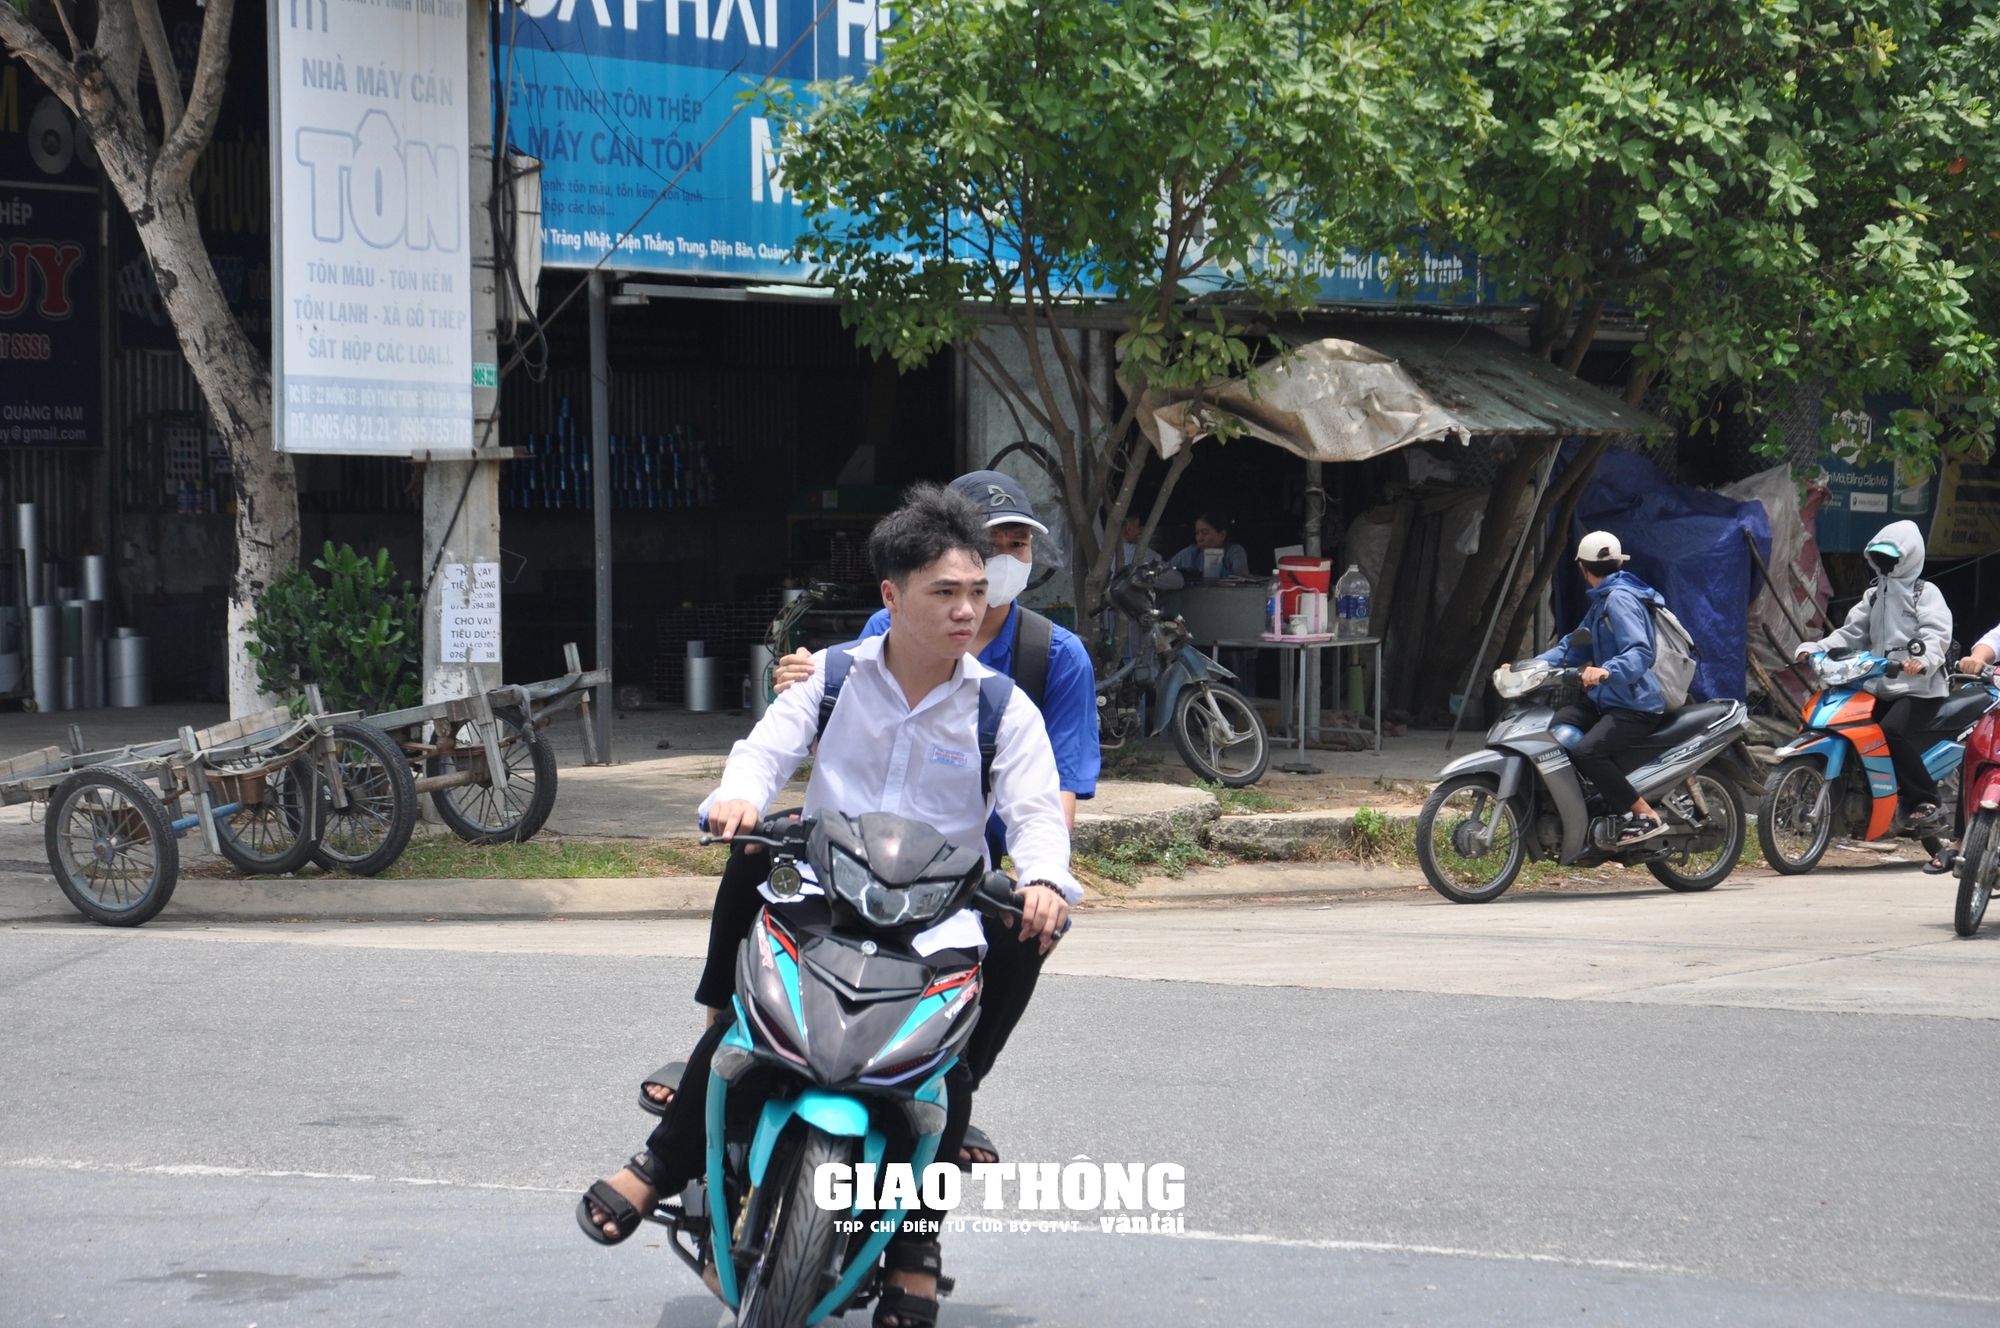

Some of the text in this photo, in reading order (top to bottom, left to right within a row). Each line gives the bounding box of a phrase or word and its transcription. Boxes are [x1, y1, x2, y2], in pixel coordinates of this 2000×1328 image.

[302, 53, 348, 92] NHÀ
[356, 60, 402, 100] MÁY
[410, 68, 453, 106] CÁN
[525, 83, 548, 109] TY
[553, 86, 607, 114] TNHH
[612, 87, 652, 119] TÔN
[657, 93, 703, 123] THÉP
[527, 120, 583, 162] MÁY
[590, 126, 643, 168] CÁN
[651, 132, 703, 172] TÔN
[295, 108, 462, 253] TÔN
[568, 179, 586, 193] tôn
[616, 183, 634, 197] tôn
[567, 197, 584, 214] các
[616, 233, 641, 255] Điện
[676, 236, 708, 259] Trung,
[710, 237, 733, 260] Điện
[735, 238, 756, 259] Bàn,
[307, 257, 337, 285] TÔN
[342, 260, 375, 288] MÀU
[388, 264, 418, 291] TÔN
[293, 293, 324, 321] TÔN
[329, 301, 368, 327] LẠNH
[383, 300, 401, 327] XÀ
[428, 304, 467, 330] THÉP
[11, 333, 51, 360] SSSC
[308, 329, 337, 359] SẮT
[342, 335, 372, 365] HỘP
[376, 337, 405, 363] CÁC
[3, 400, 84, 421] QUẢNG NAM
[312, 412, 341, 440] 0905
[343, 414, 357, 441] 48
[360, 414, 373, 441] 21
[376, 415, 390, 442] 21
[400, 415, 427, 443] 0905
[430, 417, 450, 443] 735
[453, 418, 471, 443] 779
[451, 630, 472, 639] TIÊU
[454, 617, 493, 626] CHO VAY
[1537, 749, 1562, 762] YAMAHA
